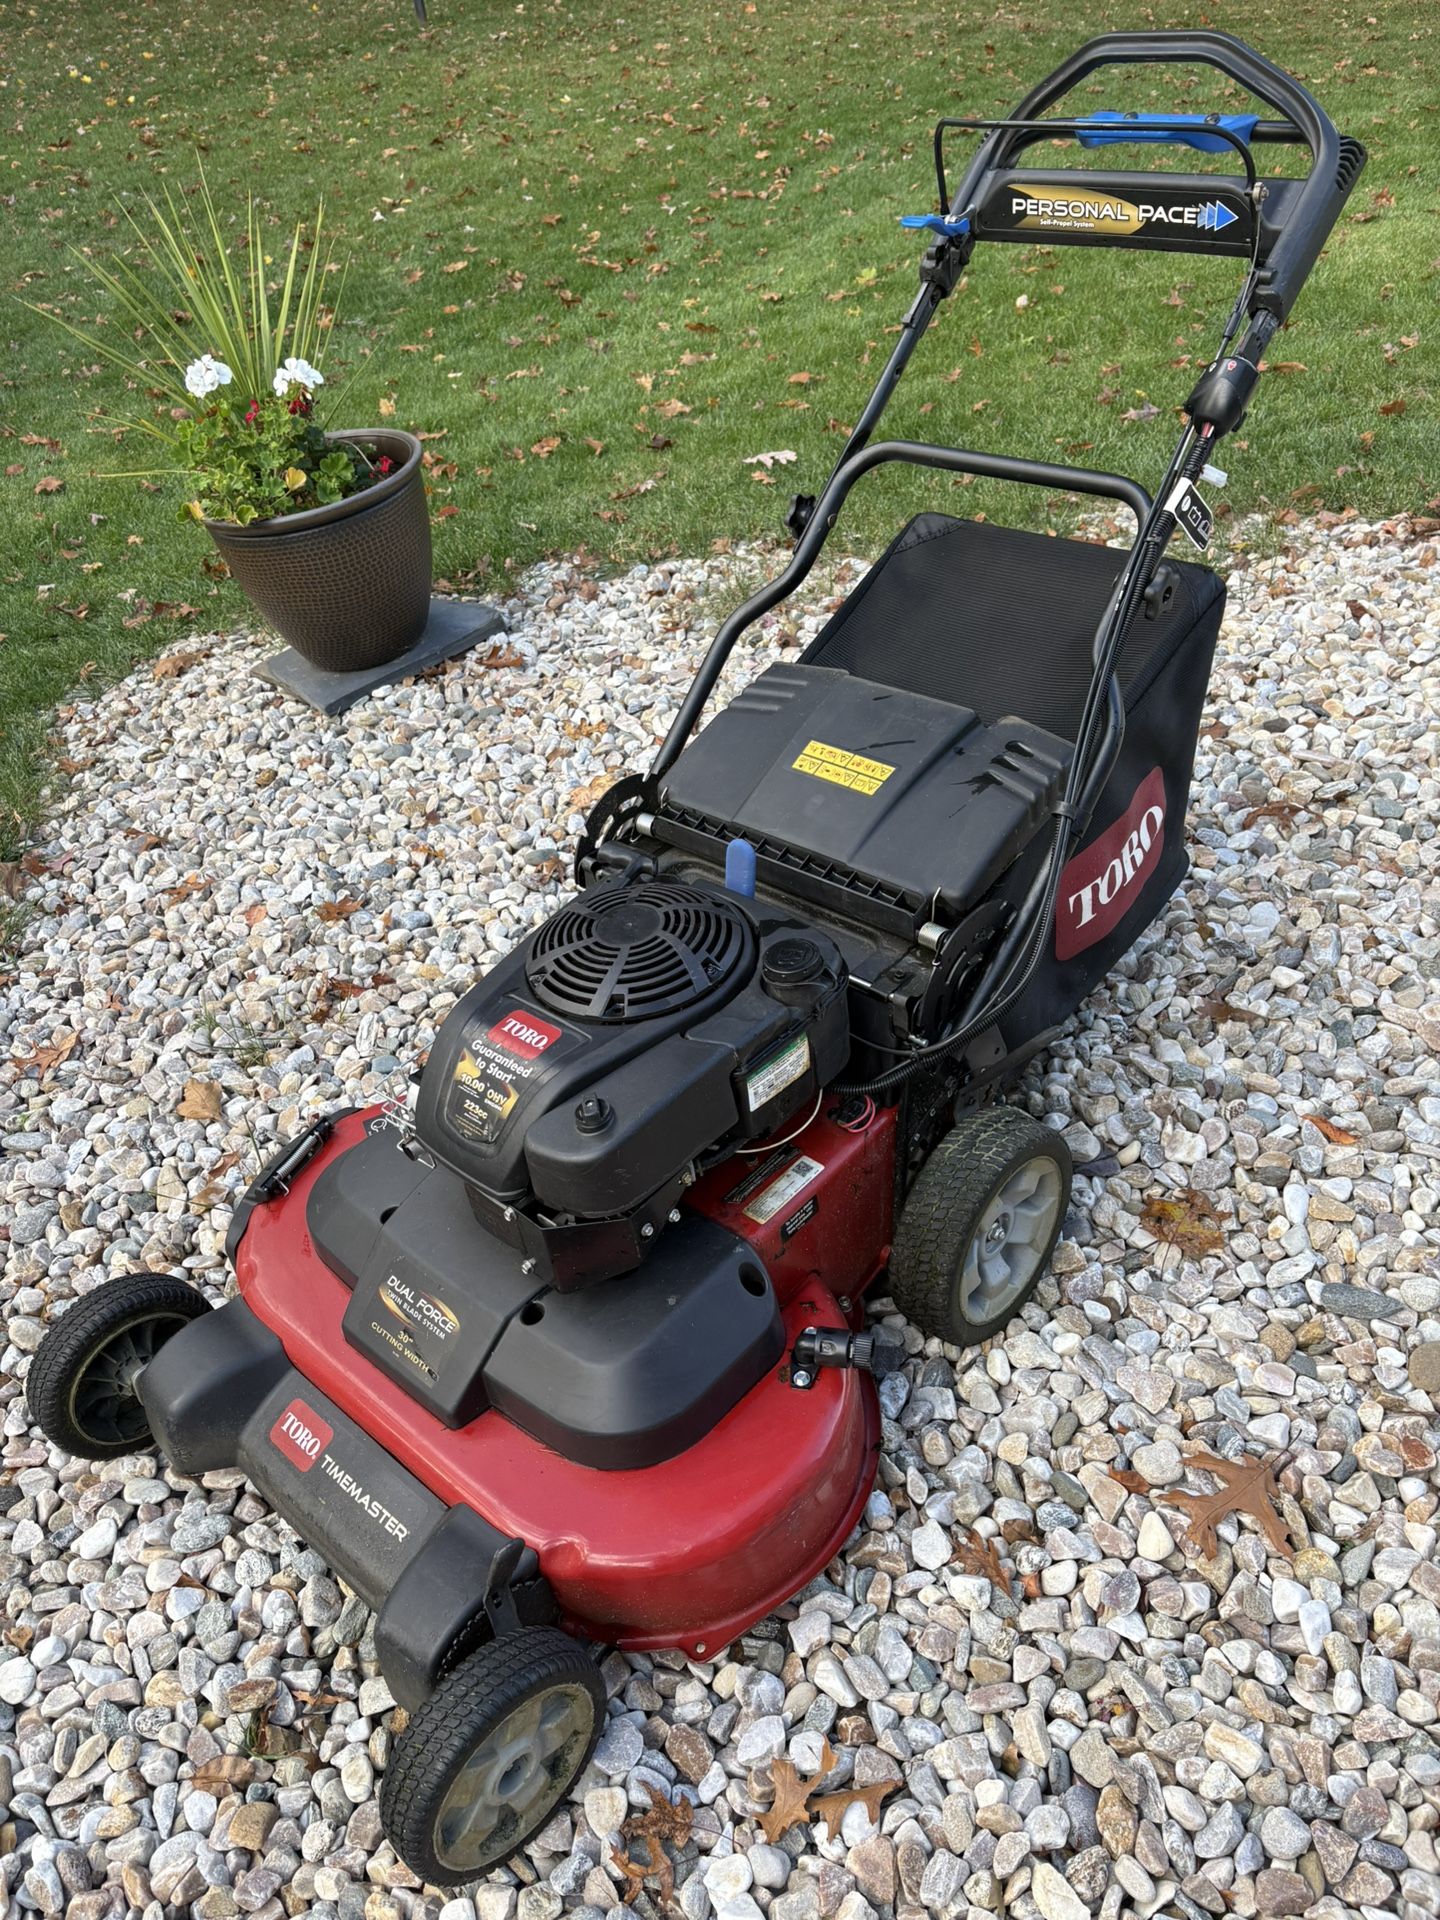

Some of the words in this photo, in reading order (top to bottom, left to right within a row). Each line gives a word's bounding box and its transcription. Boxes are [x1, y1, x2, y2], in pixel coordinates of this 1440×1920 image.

[1012, 198, 1130, 221] PERSONAL
[1138, 204, 1198, 224] PACE
[1073, 221, 1095, 229] System
[1068, 805, 1164, 929] TORO
[502, 1018, 549, 1050] TORO
[471, 1039, 533, 1078] Guaranteed
[476, 1057, 486, 1069] to
[461, 1073, 486, 1093] 10.00
[487, 1089, 508, 1105] OHV
[387, 1275, 415, 1303] DUAL
[416, 1298, 456, 1333] FORCE
[387, 1289, 403, 1306] TWIN
[402, 1302, 423, 1321] BLADE
[422, 1318, 446, 1340] SYSTEM
[371, 1321, 404, 1351] CUTTING
[404, 1347, 430, 1373] WIDTH
[281, 1412, 321, 1459] TORO
[320, 1453, 408, 1543] TIMEMASTER
